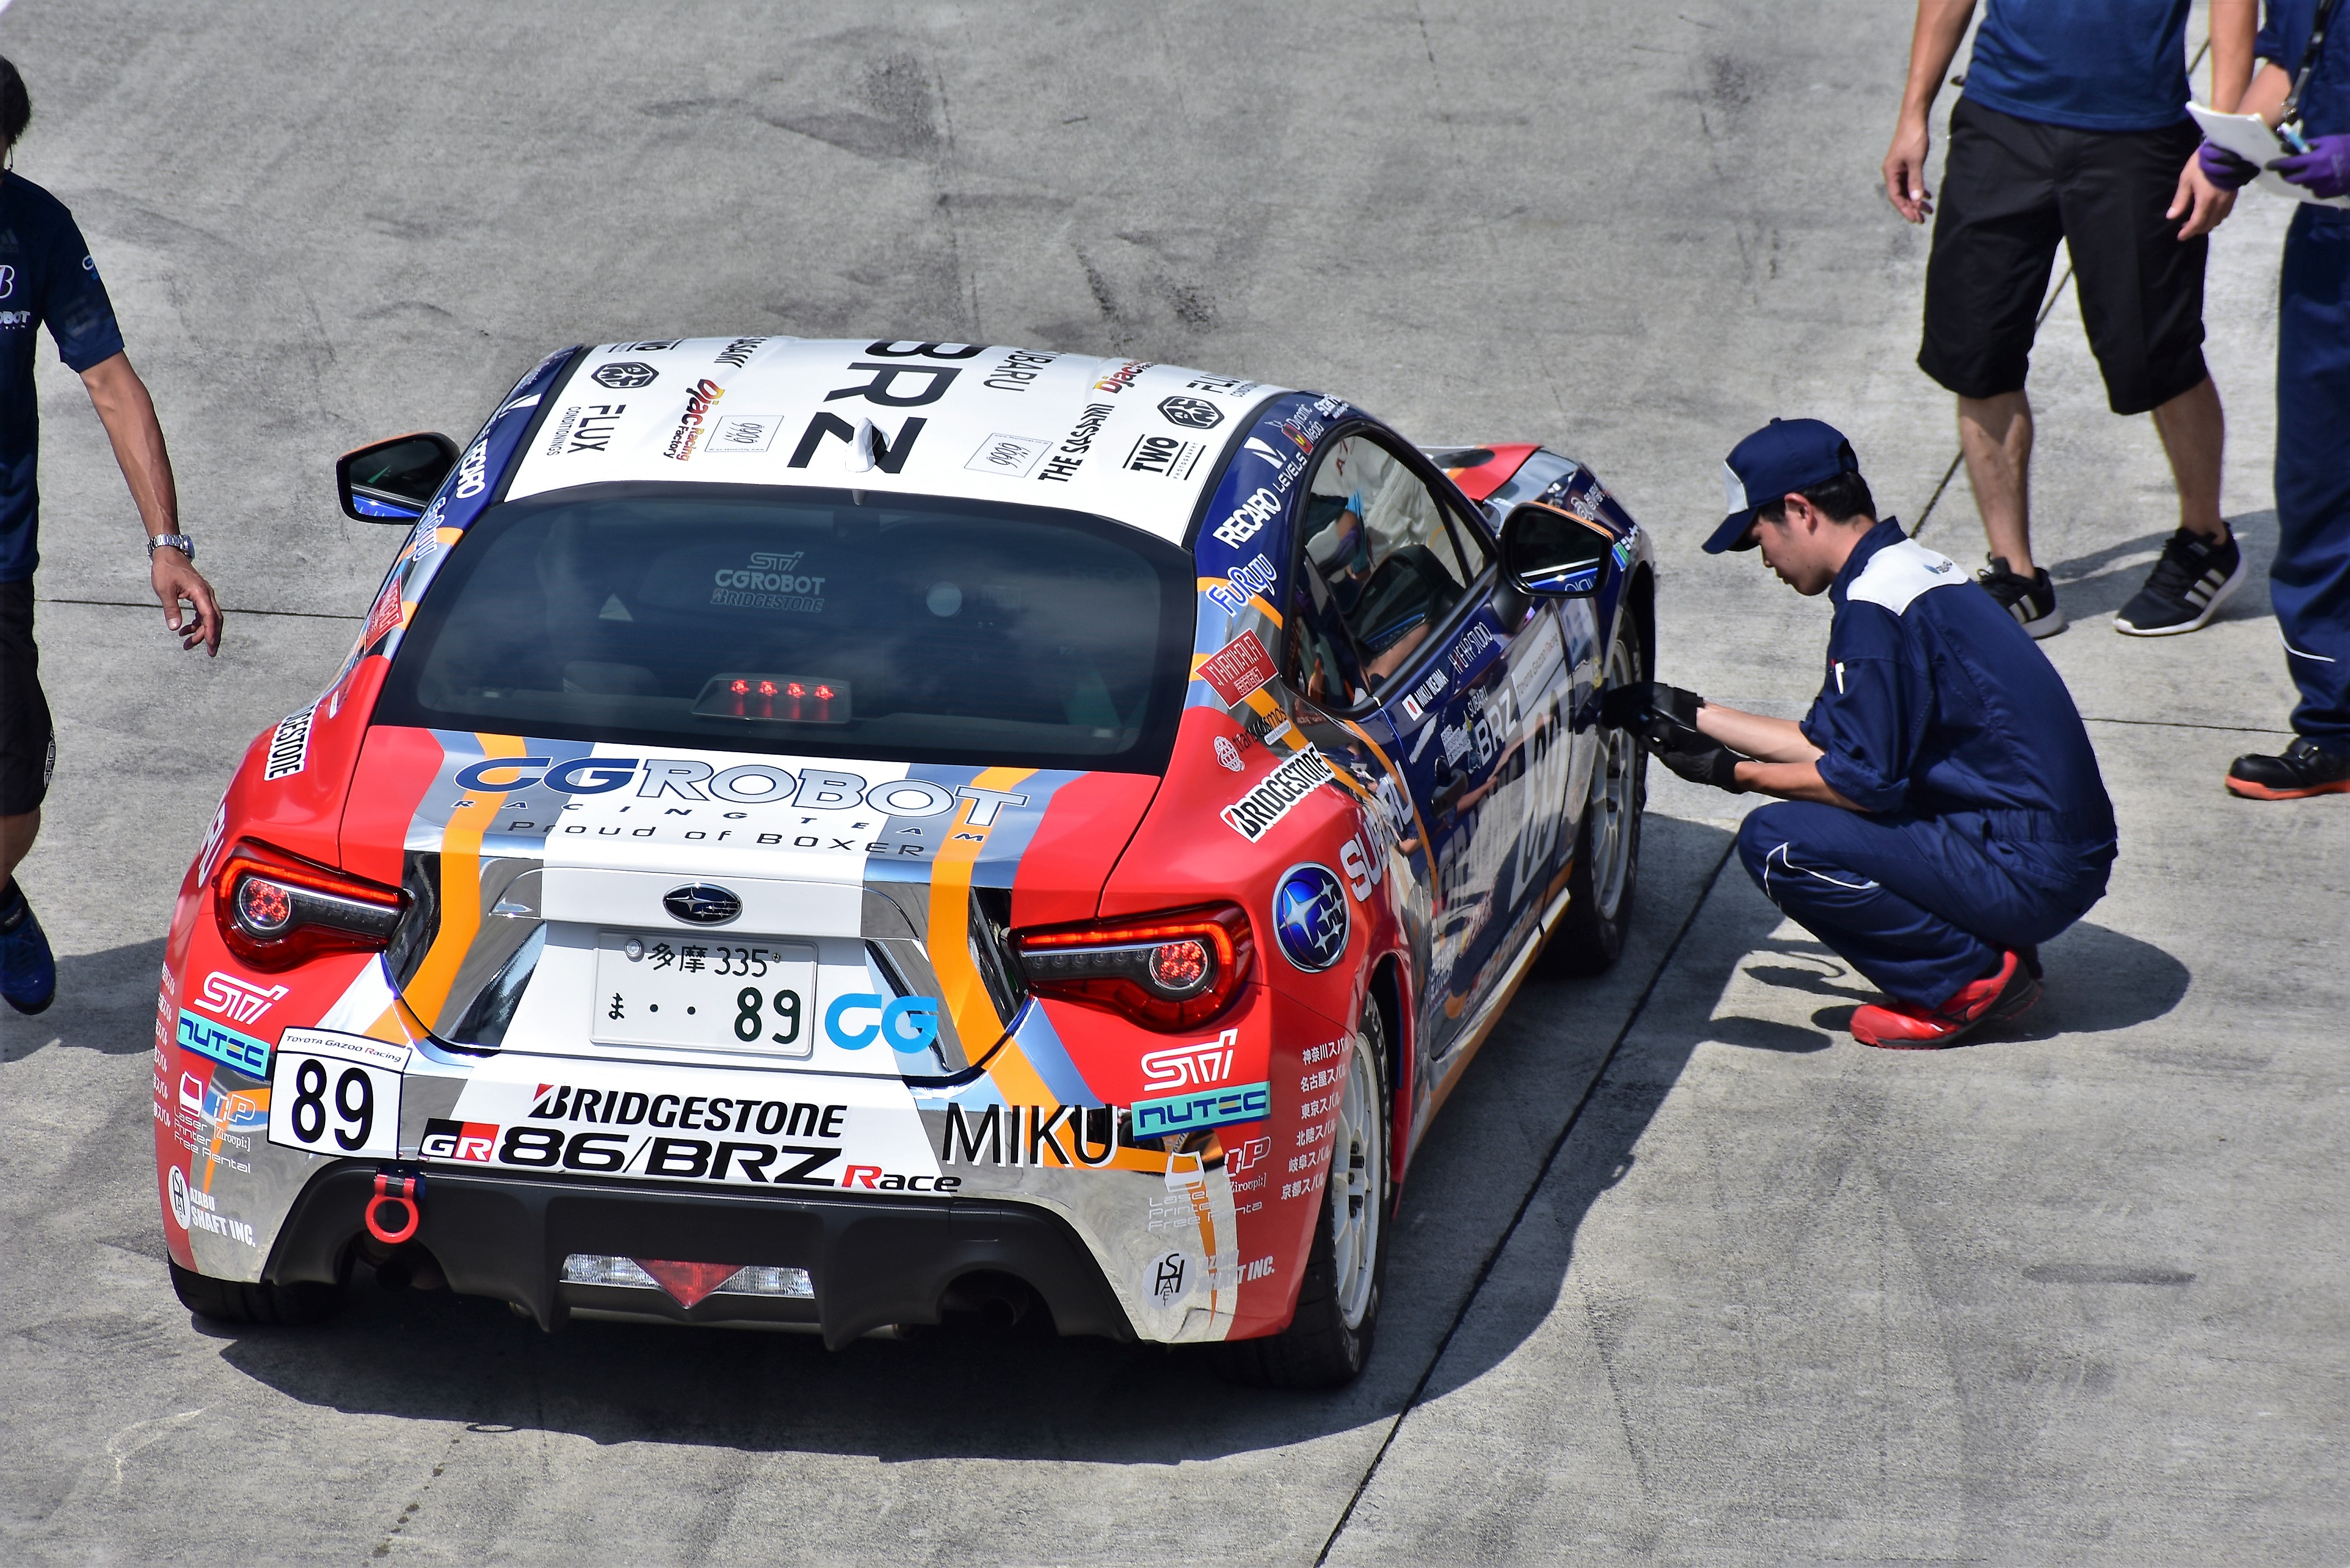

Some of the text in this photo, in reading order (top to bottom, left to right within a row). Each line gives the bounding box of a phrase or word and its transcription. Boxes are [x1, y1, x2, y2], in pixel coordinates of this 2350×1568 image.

[983, 349, 1064, 391] UBARU
[547, 406, 581, 456] CONDITIONINGS
[567, 404, 626, 454] FLUX
[663, 425, 689, 458] Factory
[676, 427, 705, 461] Racing
[1038, 403, 1115, 482] THE SASAMI
[1130, 437, 1179, 473] TWO
[1272, 452, 1307, 493] LEVELS
[1213, 488, 1282, 549] RECARO
[715, 569, 825, 595] CGROBOT
[710, 588, 824, 613] BRIDGESTONE
[1414, 684, 1433, 708] MIKU
[1467, 685, 1488, 718] SUBARU
[1475, 688, 1517, 766] BRZ
[453, 756, 1031, 827] CGROBOT
[1222, 744, 1334, 841] BRIDGESTONE
[451, 800, 985, 842] RACING TEAM
[508, 821, 925, 857] Proud of BOXER
[647, 942, 769, 977] 多摩 335
[608, 986, 801, 1044] ま 89
[825, 993, 938, 1054] CG
[286, 1035, 402, 1063] TOYOTA GAZOO Racing
[1302, 1037, 1350, 1066] 神奈川スバル
[1300, 1063, 1346, 1092] 名古屋スバル
[174, 1105, 208, 1132] Laser
[292, 1059, 374, 1151] 89
[528, 1083, 848, 1139] BRIDGESTONE
[1301, 1091, 1340, 1120] 東京スバル
[174, 1118, 212, 1146] Printer
[941, 1102, 1119, 1168] MIKU
[1296, 1117, 1336, 1147] 北陸スバル
[174, 1132, 251, 1174] Free Rental
[421, 1126, 963, 1193] GR 86/BRZ Race
[1288, 1145, 1330, 1173] 岐阜スバル
[190, 1187, 215, 1212] AZABU
[1281, 1171, 1325, 1201] 京都スバル
[190, 1206, 256, 1248] SHAFT INC.
[1149, 1216, 1201, 1230] Free
[1247, 1255, 1275, 1281] INC.
